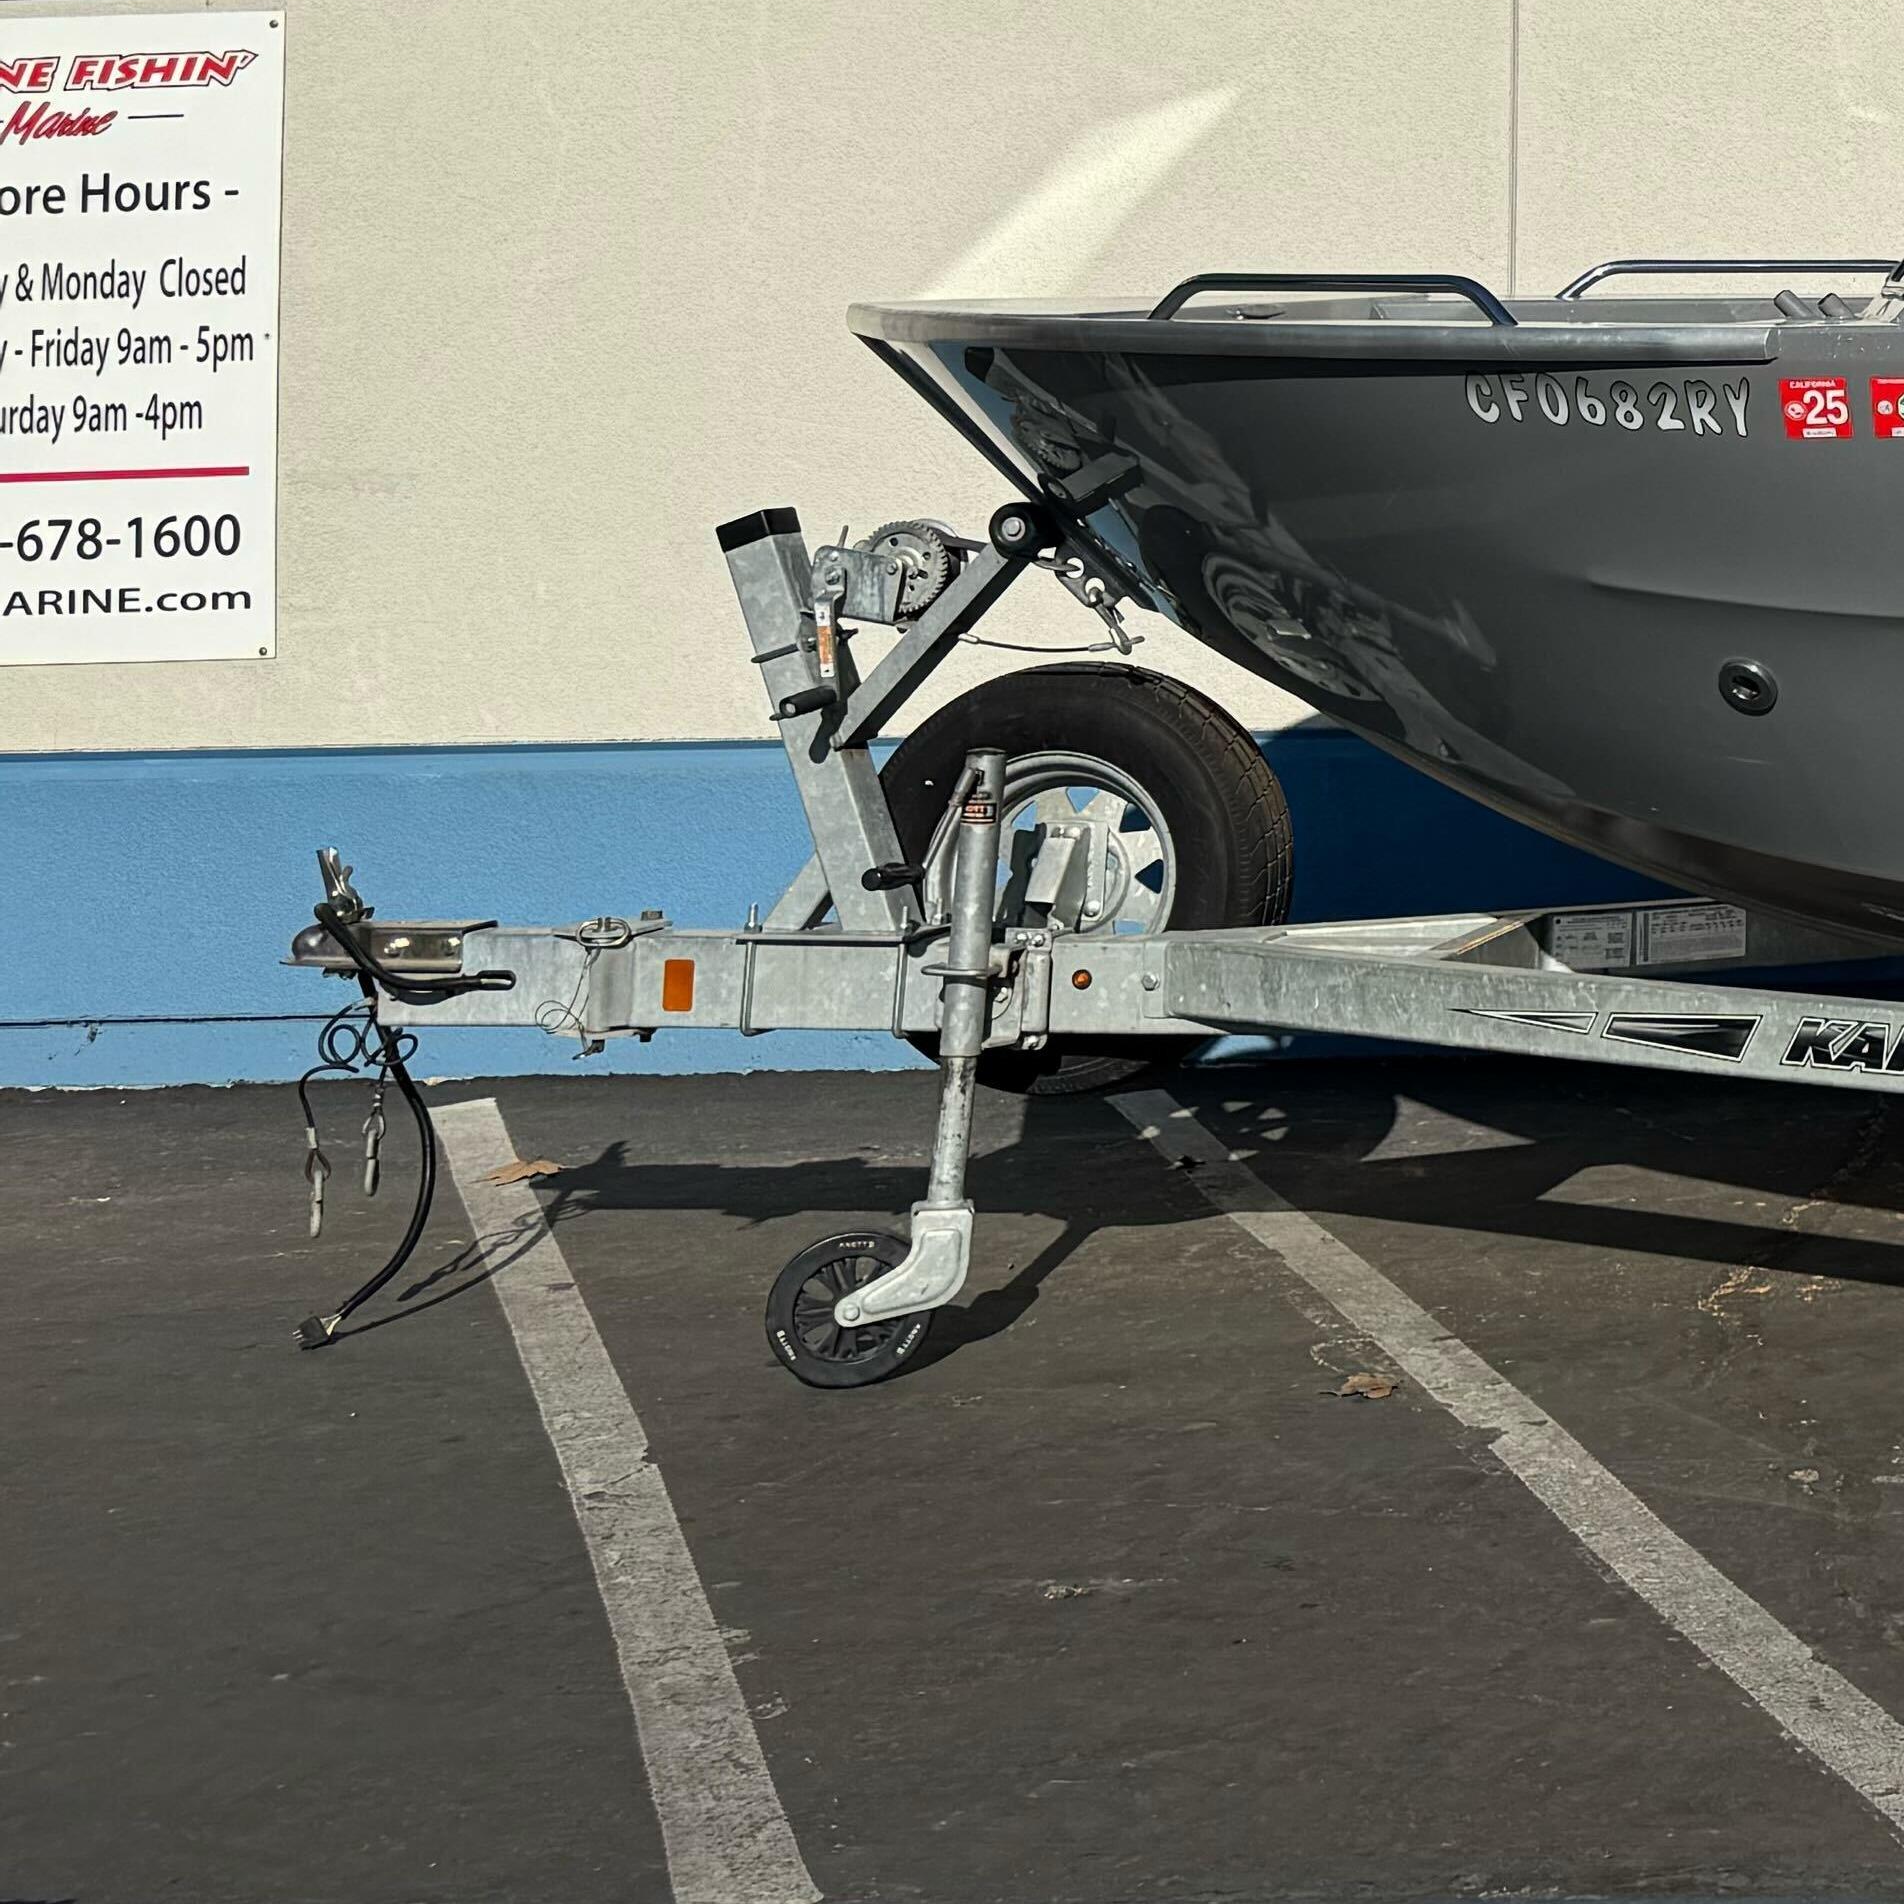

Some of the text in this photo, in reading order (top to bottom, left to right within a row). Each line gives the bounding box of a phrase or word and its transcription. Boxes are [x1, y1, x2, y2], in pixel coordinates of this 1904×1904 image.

[65, 49, 258, 91] FISHIN'
[0, 100, 118, 146] Marine
[0, 184, 66, 215] ore
[81, 173, 211, 213] Hours
[15, 263, 34, 302] &
[41, 258, 146, 309] Monday
[159, 255, 246, 297] Closed
[31, 326, 110, 376] Friday
[117, 327, 171, 365] 9am
[196, 325, 254, 373] 5pm
[73, 395, 127, 432] 9am
[1803, 389, 1849, 424] 25
[0, 514, 241, 562] -678-1600
[2, 588, 251, 616] ARINE.com
